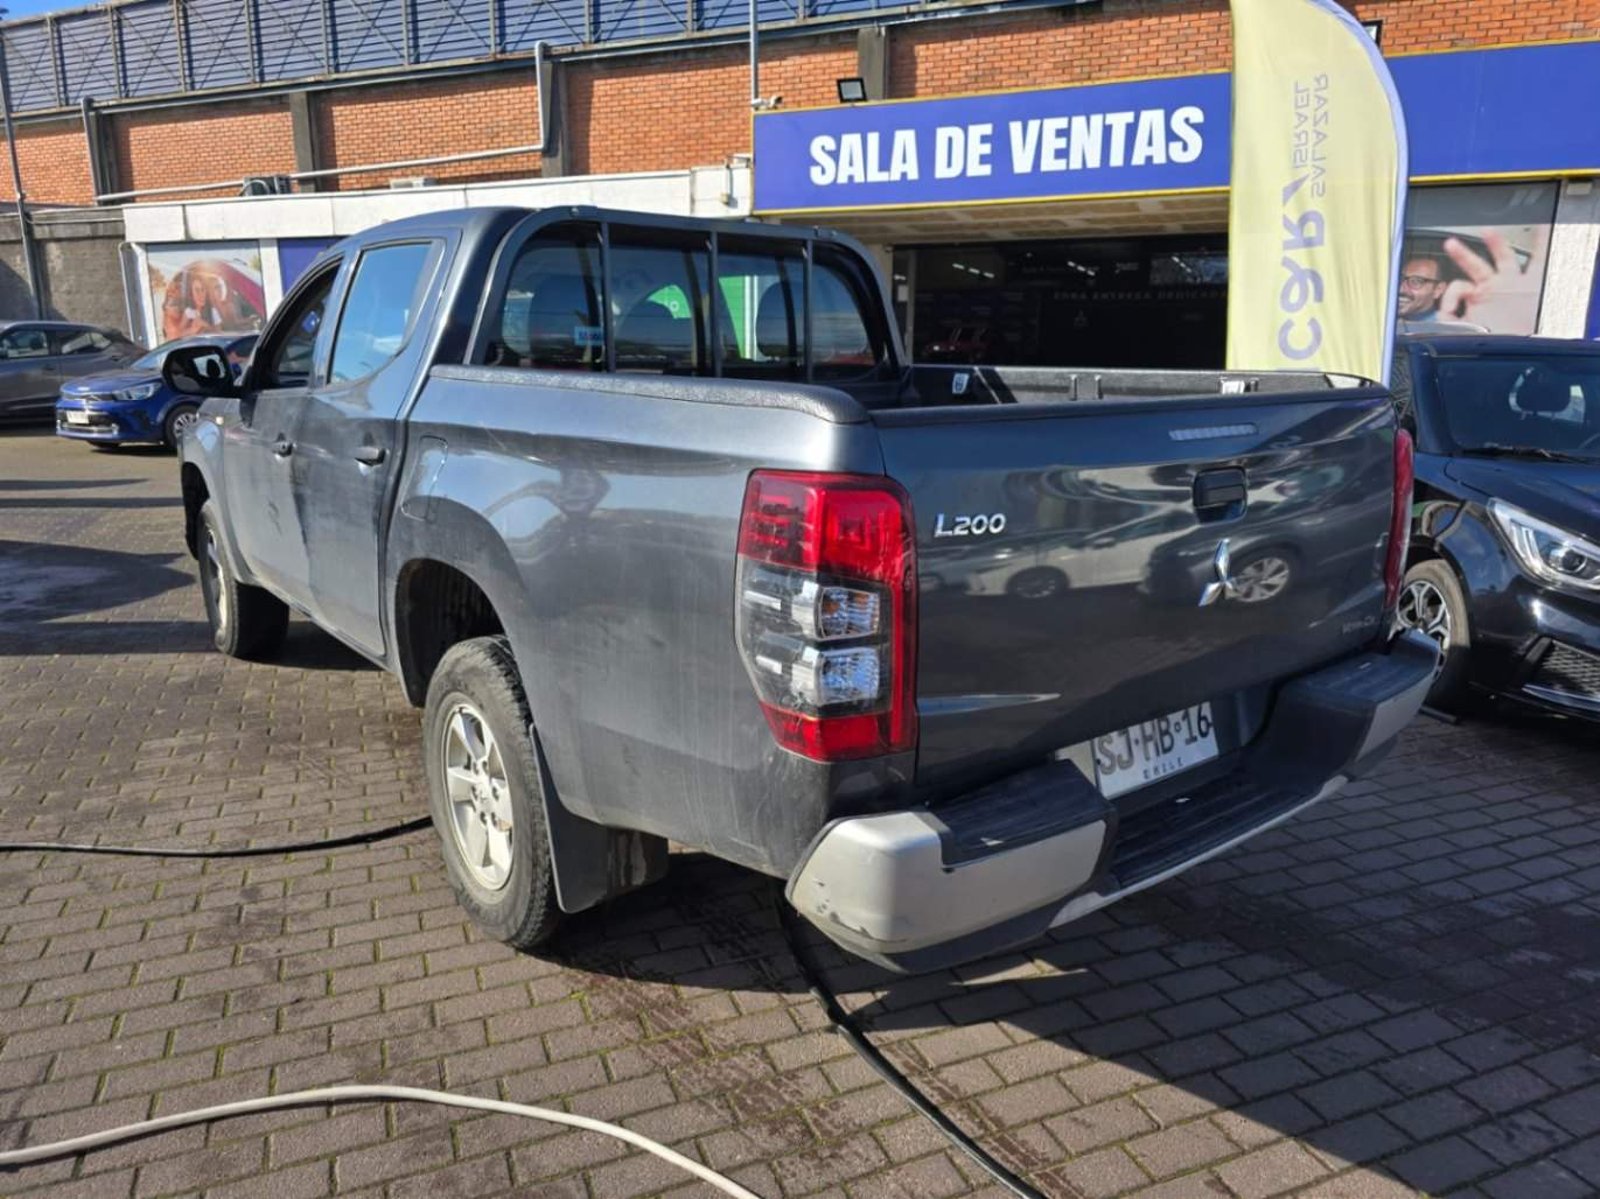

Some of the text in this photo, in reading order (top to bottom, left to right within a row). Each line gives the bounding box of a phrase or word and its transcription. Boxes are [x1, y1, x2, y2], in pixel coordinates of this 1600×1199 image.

[809, 106, 1204, 186] SALA DE VENTAS
[934, 513, 1006, 538] L200
